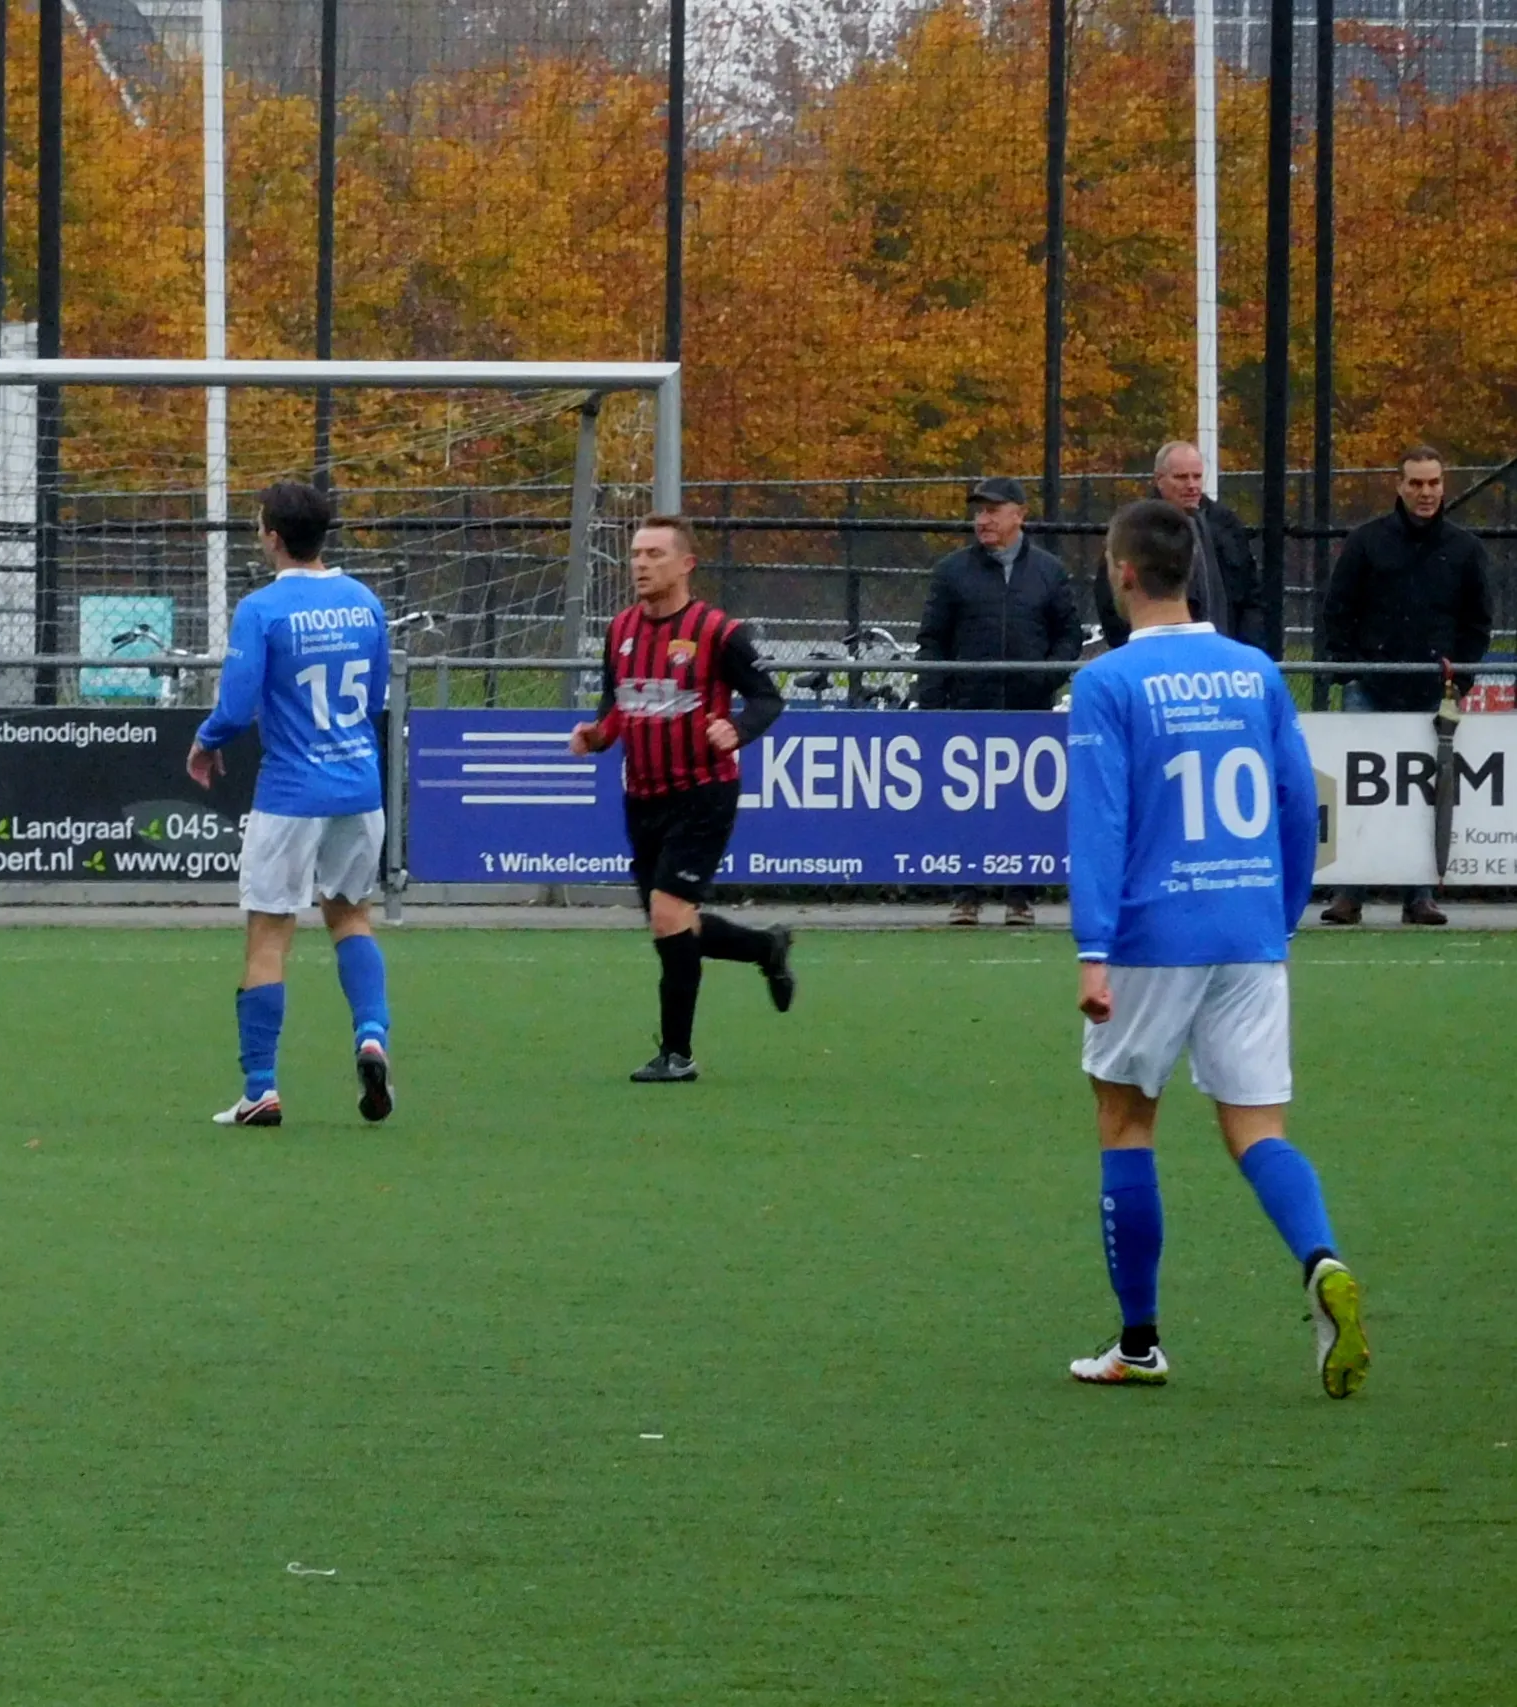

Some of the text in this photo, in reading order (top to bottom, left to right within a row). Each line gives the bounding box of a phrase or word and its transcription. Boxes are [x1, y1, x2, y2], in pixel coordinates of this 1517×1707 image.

[290, 607, 376, 633] moonen
[295, 658, 370, 731] 15
[1143, 670, 1265, 705] moonen
[941, 735, 1068, 812] SPO
[1346, 751, 1505, 807] BRM
[1163, 746, 1271, 841] 10
[11, 816, 135, 845] Landgraaf
[749, 853, 863, 874] Brunssum
[894, 854, 915, 874] T.
[921, 854, 962, 874] 045
[982, 854, 1023, 874] 525
[1029, 854, 1055, 874] 70
[1446, 858, 1479, 875] 433
[1485, 858, 1507, 875] KE
